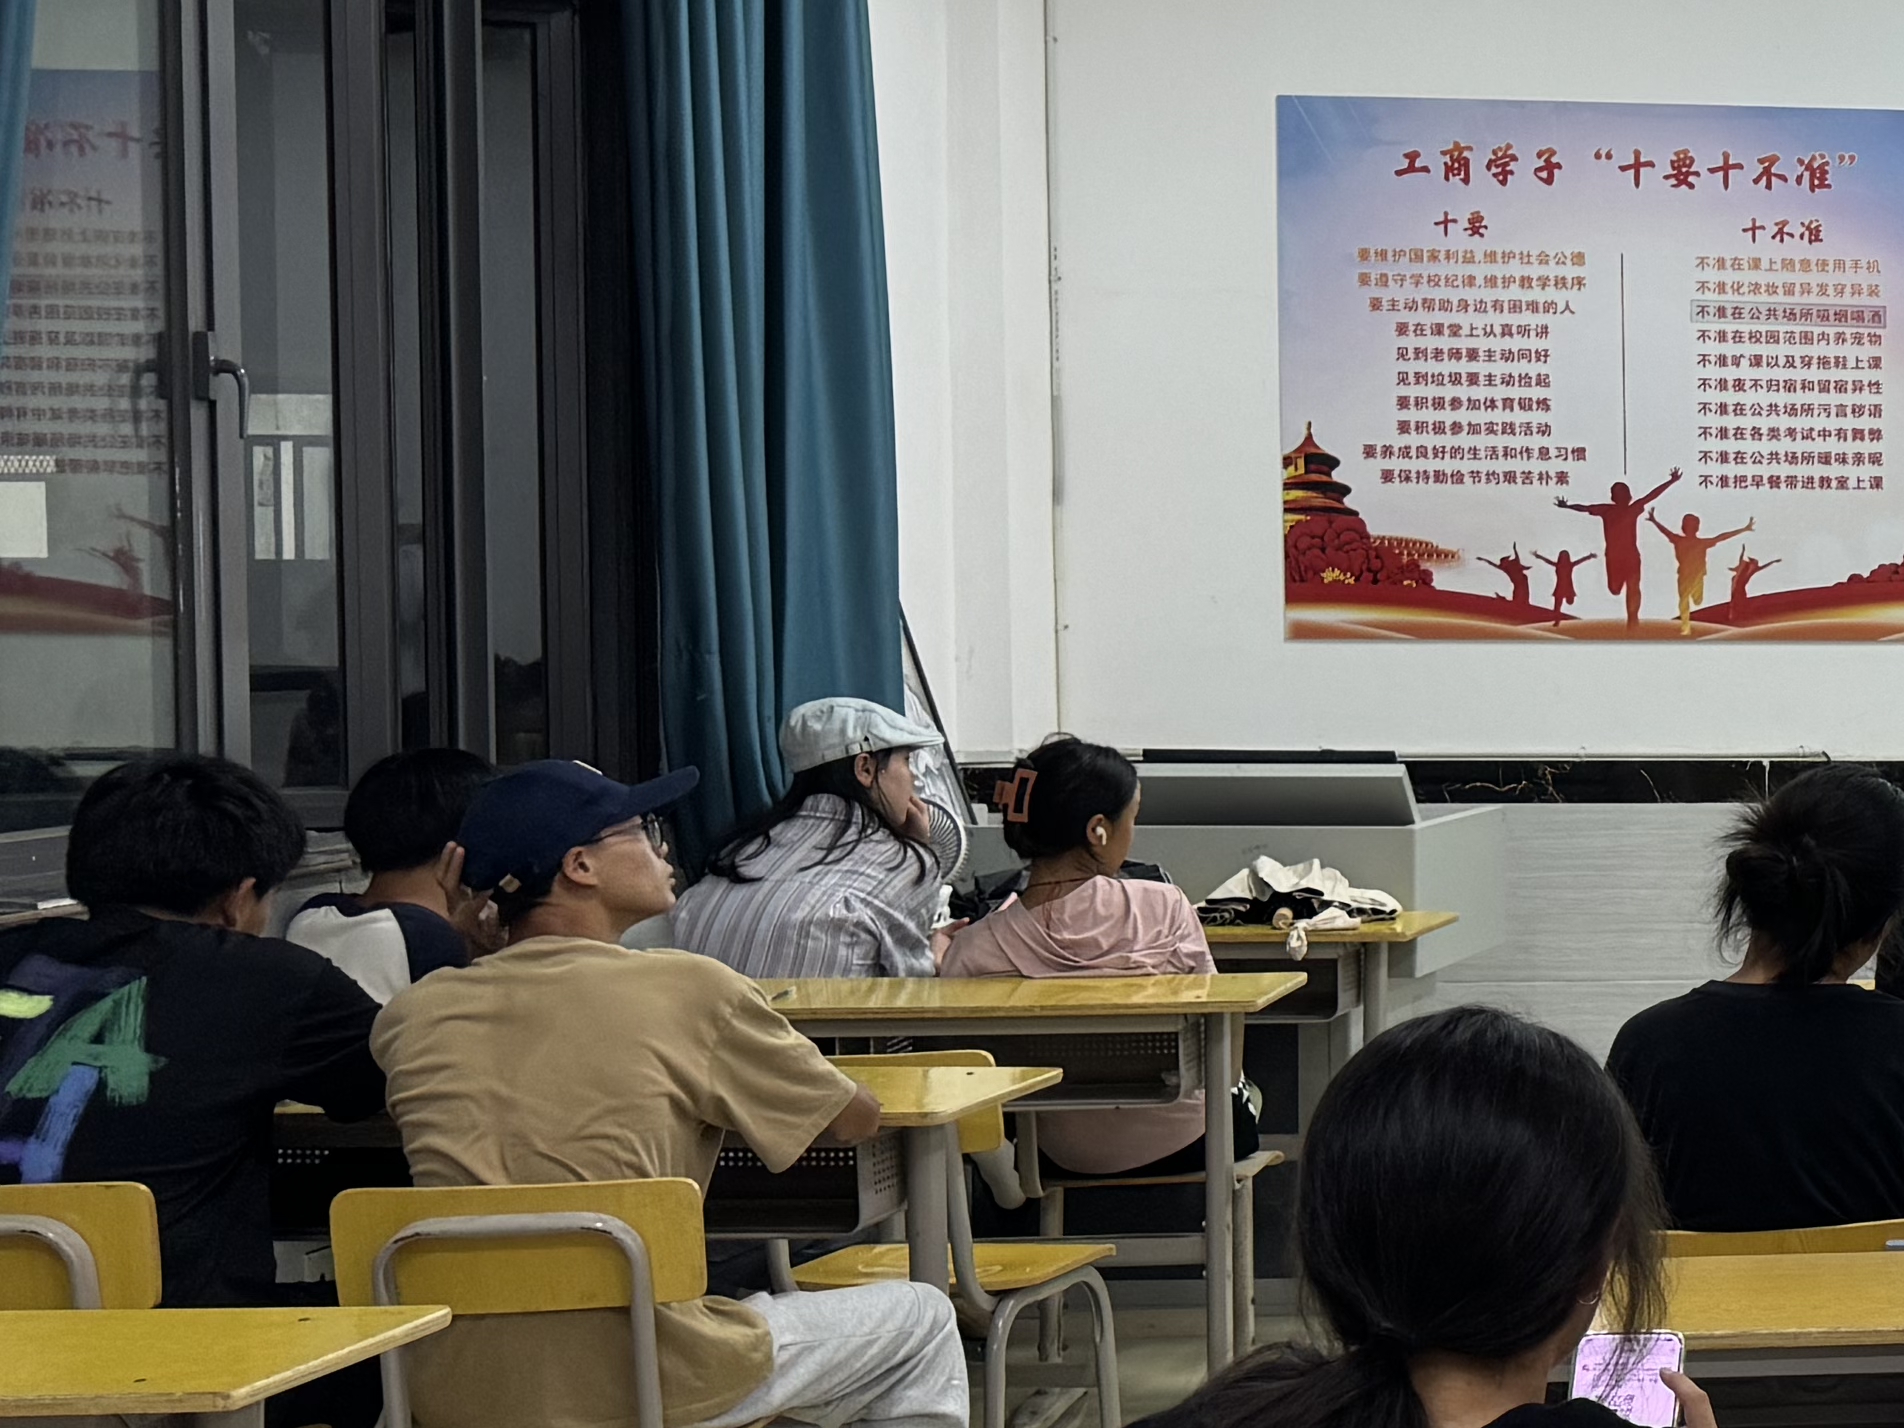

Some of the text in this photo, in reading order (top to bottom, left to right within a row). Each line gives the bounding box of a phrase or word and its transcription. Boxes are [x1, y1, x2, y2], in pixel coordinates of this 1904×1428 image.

[1434, 210, 1489, 239] 十要
[1742, 217, 1824, 246] 十不准
[1695, 255, 1882, 275] 不准在课上随意使用手机
[1368, 296, 1576, 316] 要主动帮助身边有困难的人
[1394, 321, 1550, 340] 要在课堂上认真听讲
[1696, 328, 1883, 348] 不准在校园范围内养宠物
[1395, 346, 1551, 364] 见到老师要主动问好
[1696, 352, 1883, 371] 不准旷课以及穿拖鞋上课
[1395, 395, 1552, 413] 要积极参加体育锻炼
[1395, 419, 1552, 438] 要积极参加实践活动
[1362, 444, 1588, 463] 要养成良好的生活和作息习惯
[1380, 468, 1571, 487] 要保持勤俭节约艰苦朴素
[1698, 473, 1885, 493] 不准把早餐带进教室上课
